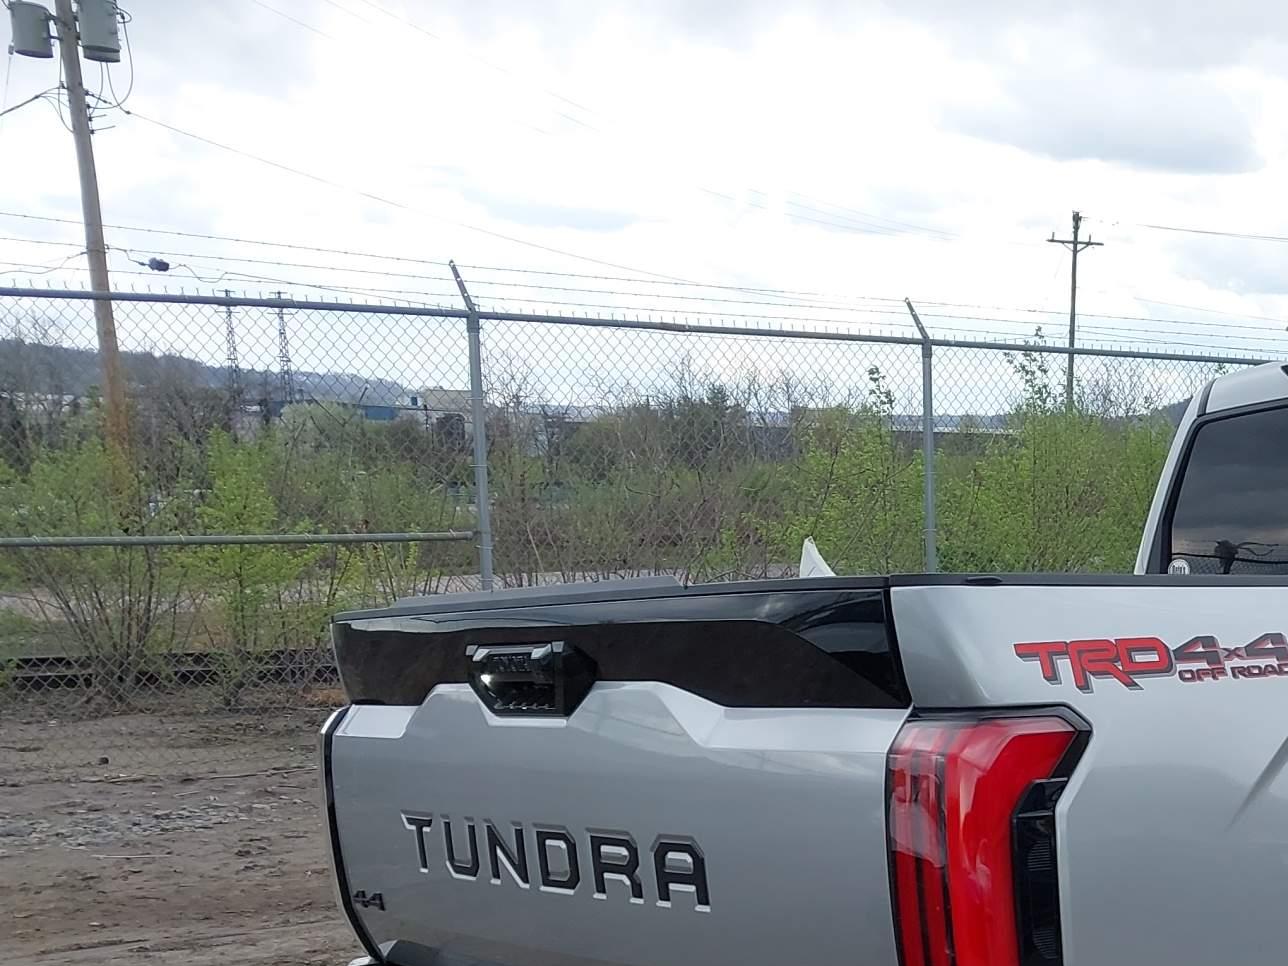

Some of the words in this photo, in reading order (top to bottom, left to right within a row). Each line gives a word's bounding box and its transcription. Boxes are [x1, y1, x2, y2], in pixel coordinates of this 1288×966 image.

[1013, 635, 1177, 694] TRD
[1178, 666, 1228, 683] OFF
[400, 809, 711, 912] TUNDRA
